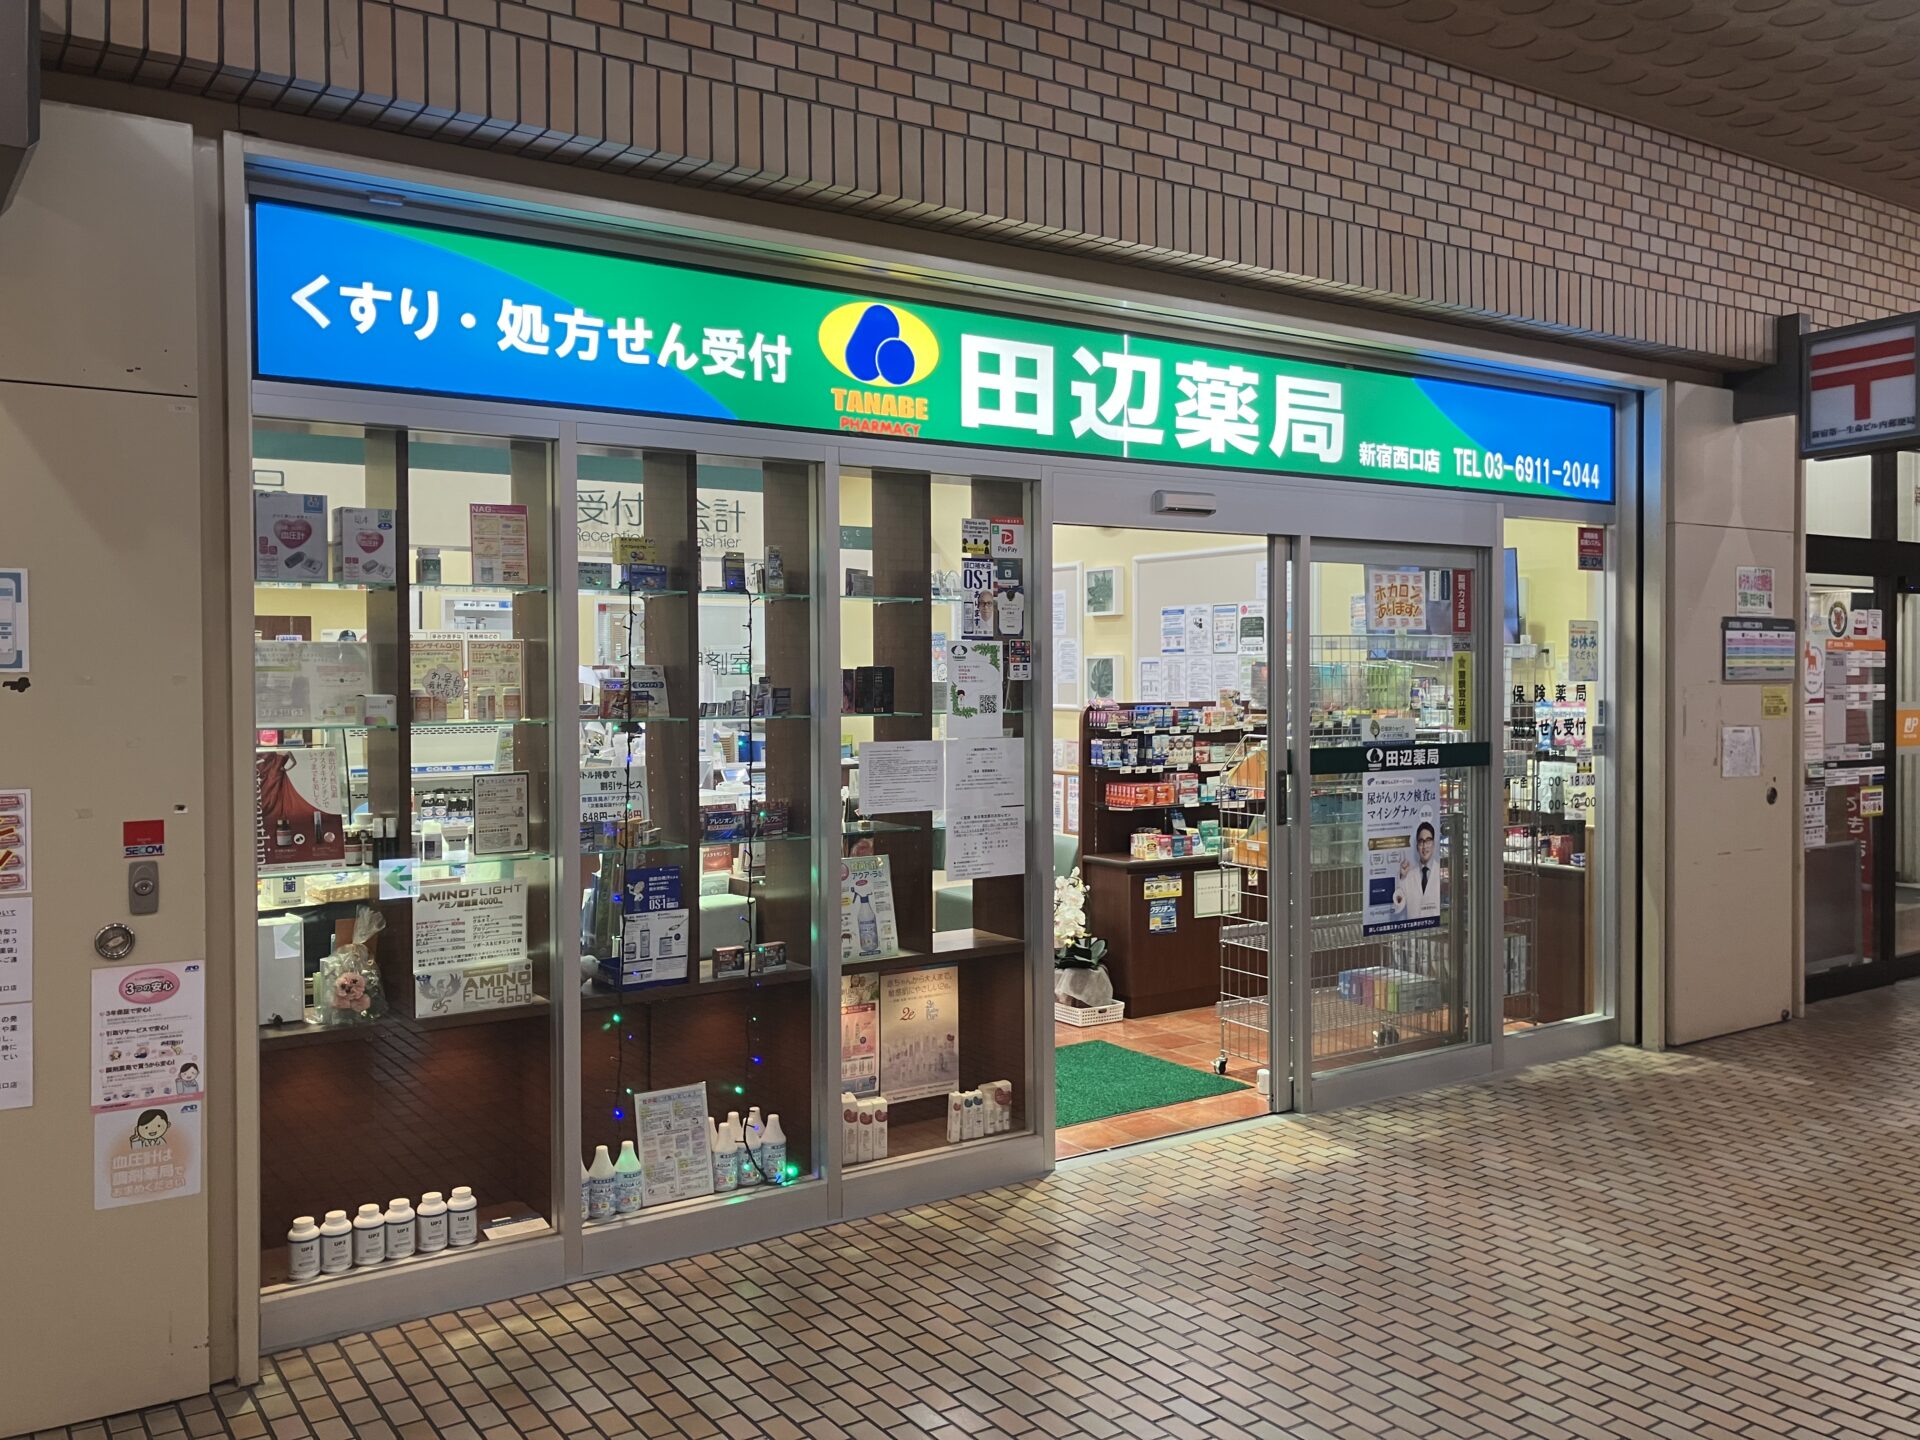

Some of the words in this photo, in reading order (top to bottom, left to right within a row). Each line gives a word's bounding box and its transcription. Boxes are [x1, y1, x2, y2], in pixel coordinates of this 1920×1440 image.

[290, 274, 793, 384] くすり・処方せん受付
[830, 387, 929, 421] TANABE
[960, 331, 1346, 465] 田辺薬局
[840, 415, 921, 438] PHARMACY
[1358, 441, 1441, 474] 新宿西口店
[1453, 447, 1482, 479] TEL
[1483, 451, 1600, 490] 03-6911-2044
[576, 490, 644, 526] 受付
[697, 534, 741, 549] ashier
[963, 568, 992, 590] OS-1
[1375, 583, 1421, 601] ホカロン
[1512, 684, 1587, 703] 保険薬局
[1512, 717, 1587, 739] 処方せん受付
[1385, 748, 1440, 768] 田辺薬局
[1367, 788, 1436, 806] 尿がんリスク検査は
[1367, 804, 1418, 820] マイシグナル
[416, 884, 523, 903] AMINOFLIGHT
[125, 980, 174, 996] 3つの安心
[464, 970, 531, 991] AMINO
[463, 982, 532, 1002] FLIGHT
[0, 1081, 18, 1089] 口店
